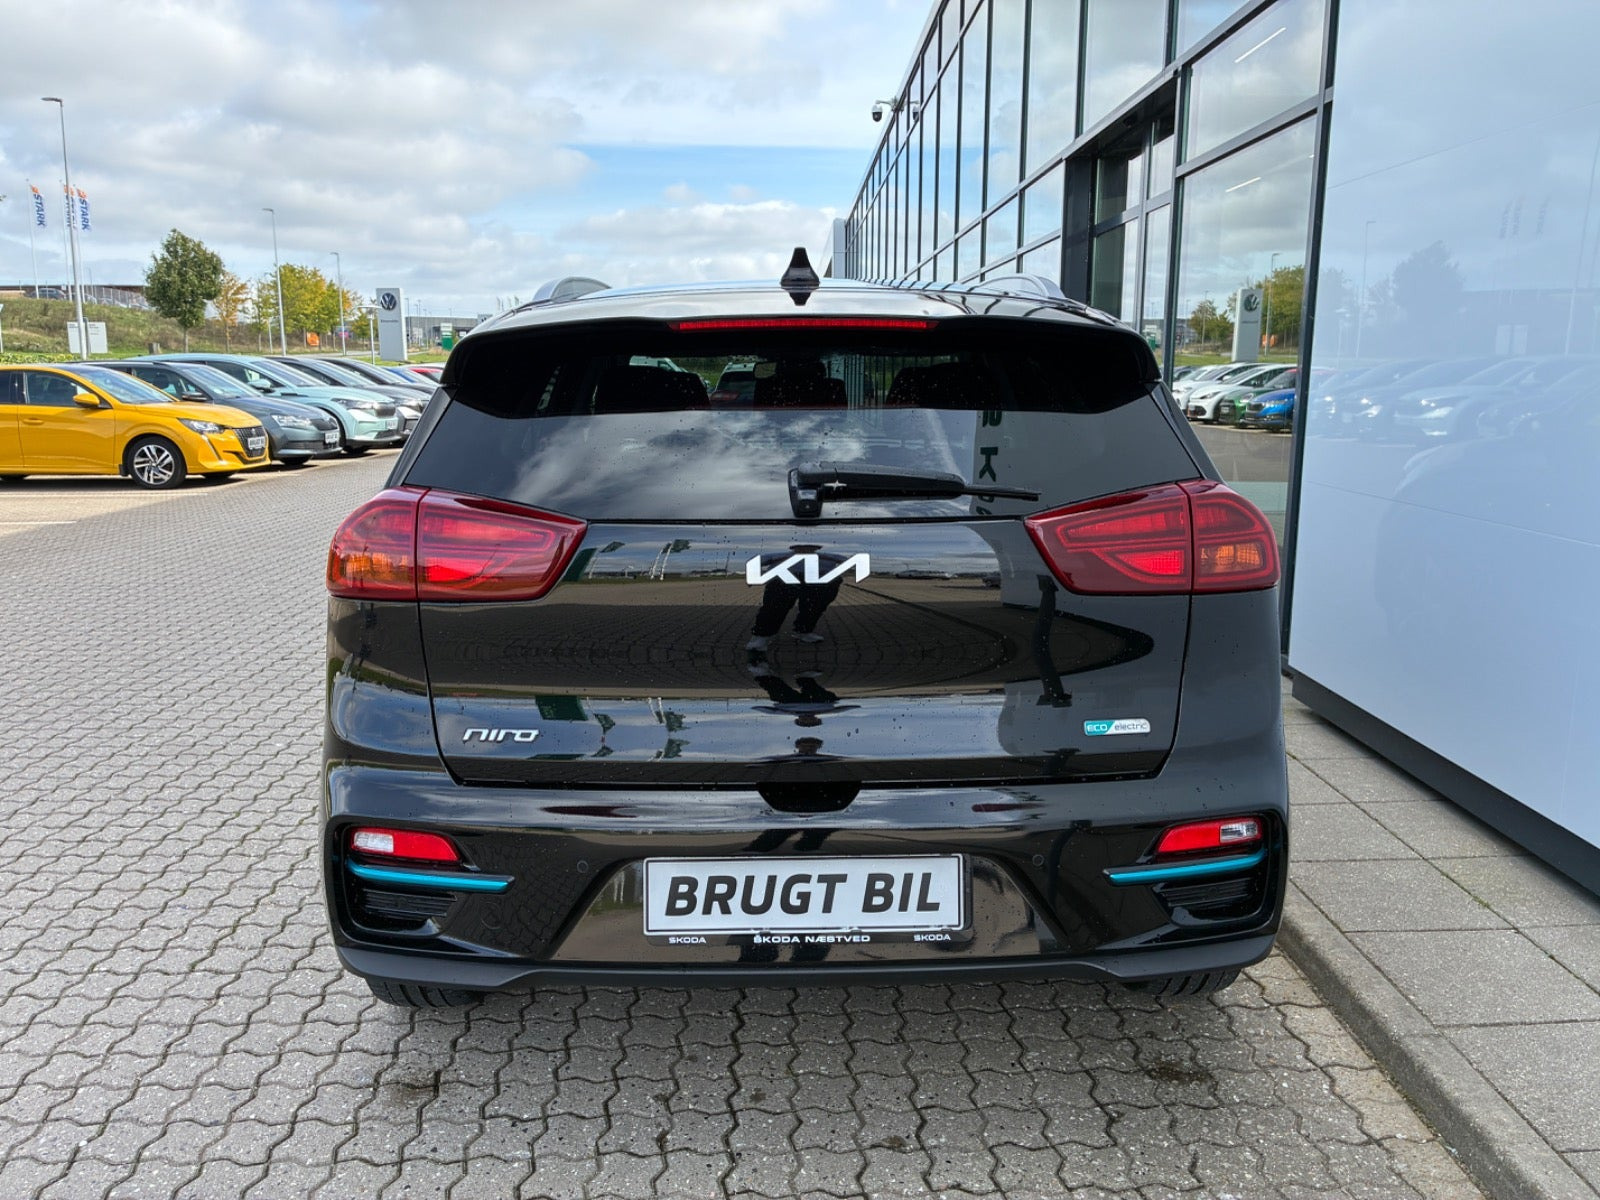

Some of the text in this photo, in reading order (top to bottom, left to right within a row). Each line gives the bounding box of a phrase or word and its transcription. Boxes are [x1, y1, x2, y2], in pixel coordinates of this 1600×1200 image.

[33, 194, 46, 227] STARK
[79, 197, 91, 230] STARK
[746, 553, 870, 584] KIA
[664, 872, 941, 916] BRUGT BIL
[805, 935, 871, 943] NÆSTVED
